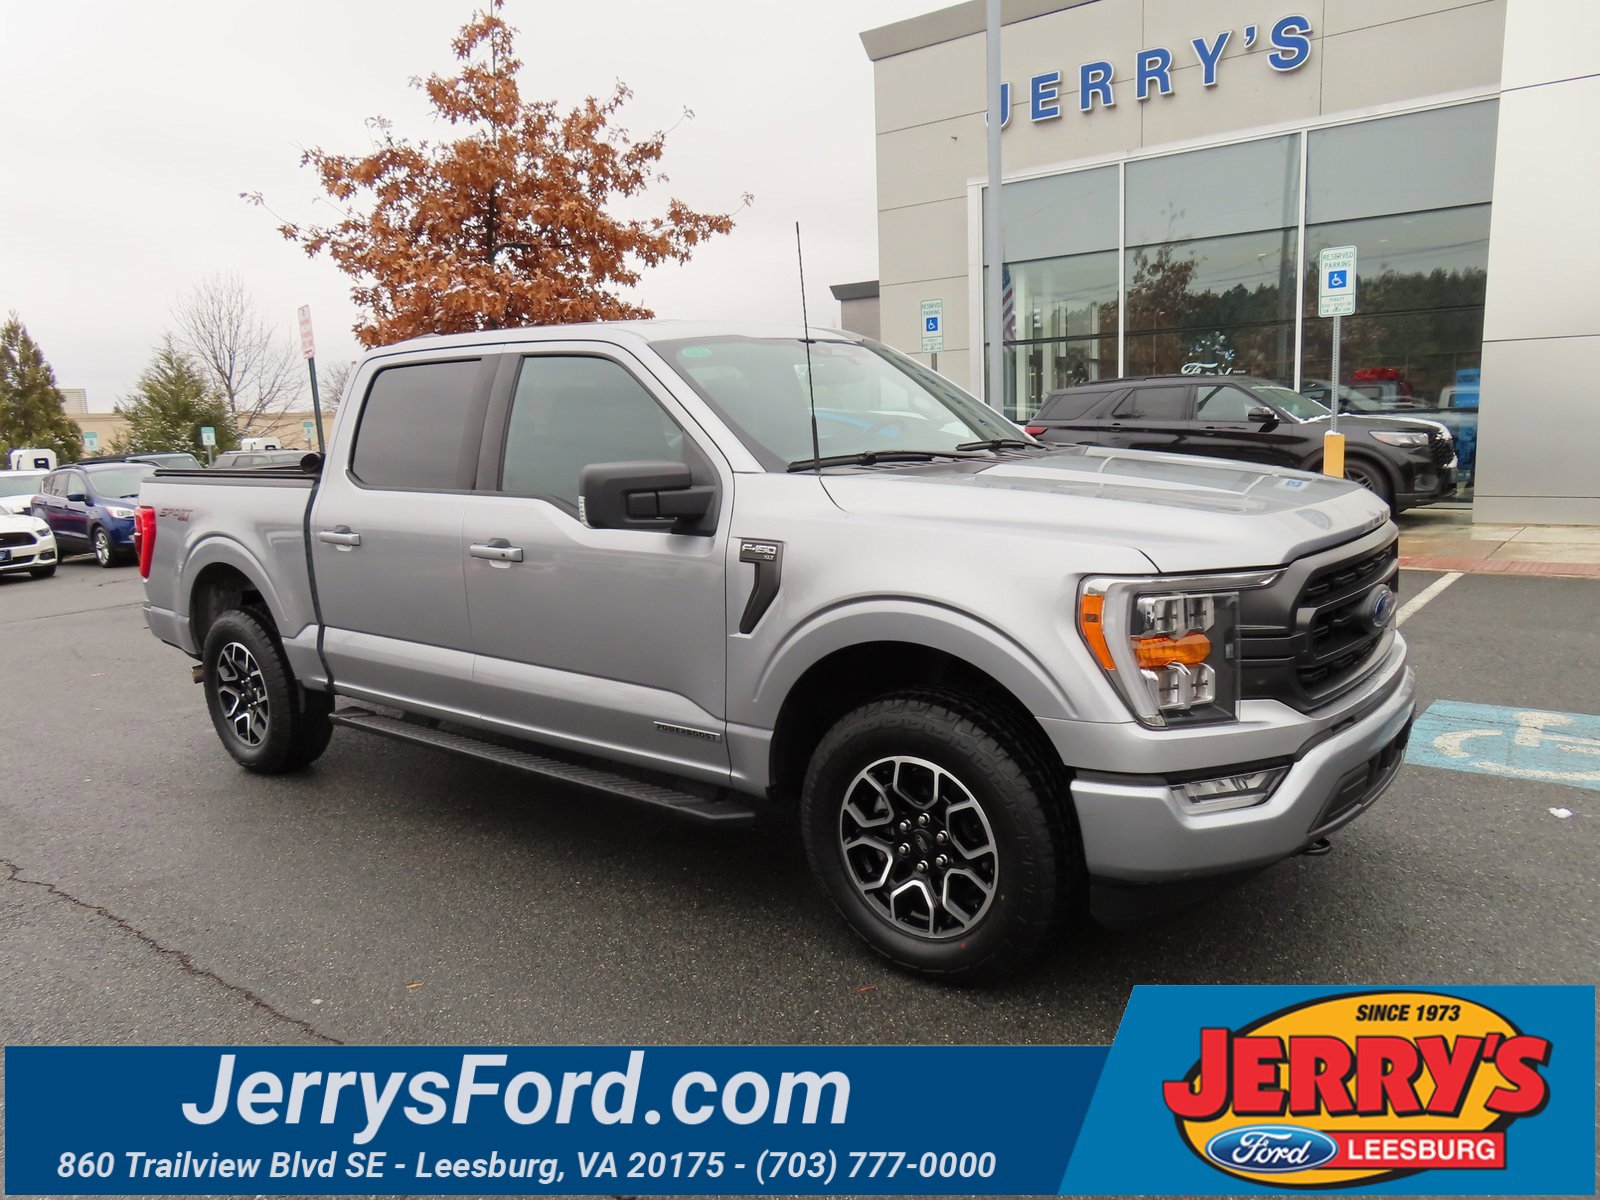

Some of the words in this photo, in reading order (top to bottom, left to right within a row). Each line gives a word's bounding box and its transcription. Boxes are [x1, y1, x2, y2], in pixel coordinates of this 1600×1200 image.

[985, 13, 1314, 130] JERRY'S
[1322, 252, 1353, 261] RESERVED
[1325, 261, 1352, 269] PARKING
[742, 543, 777, 554] F-150
